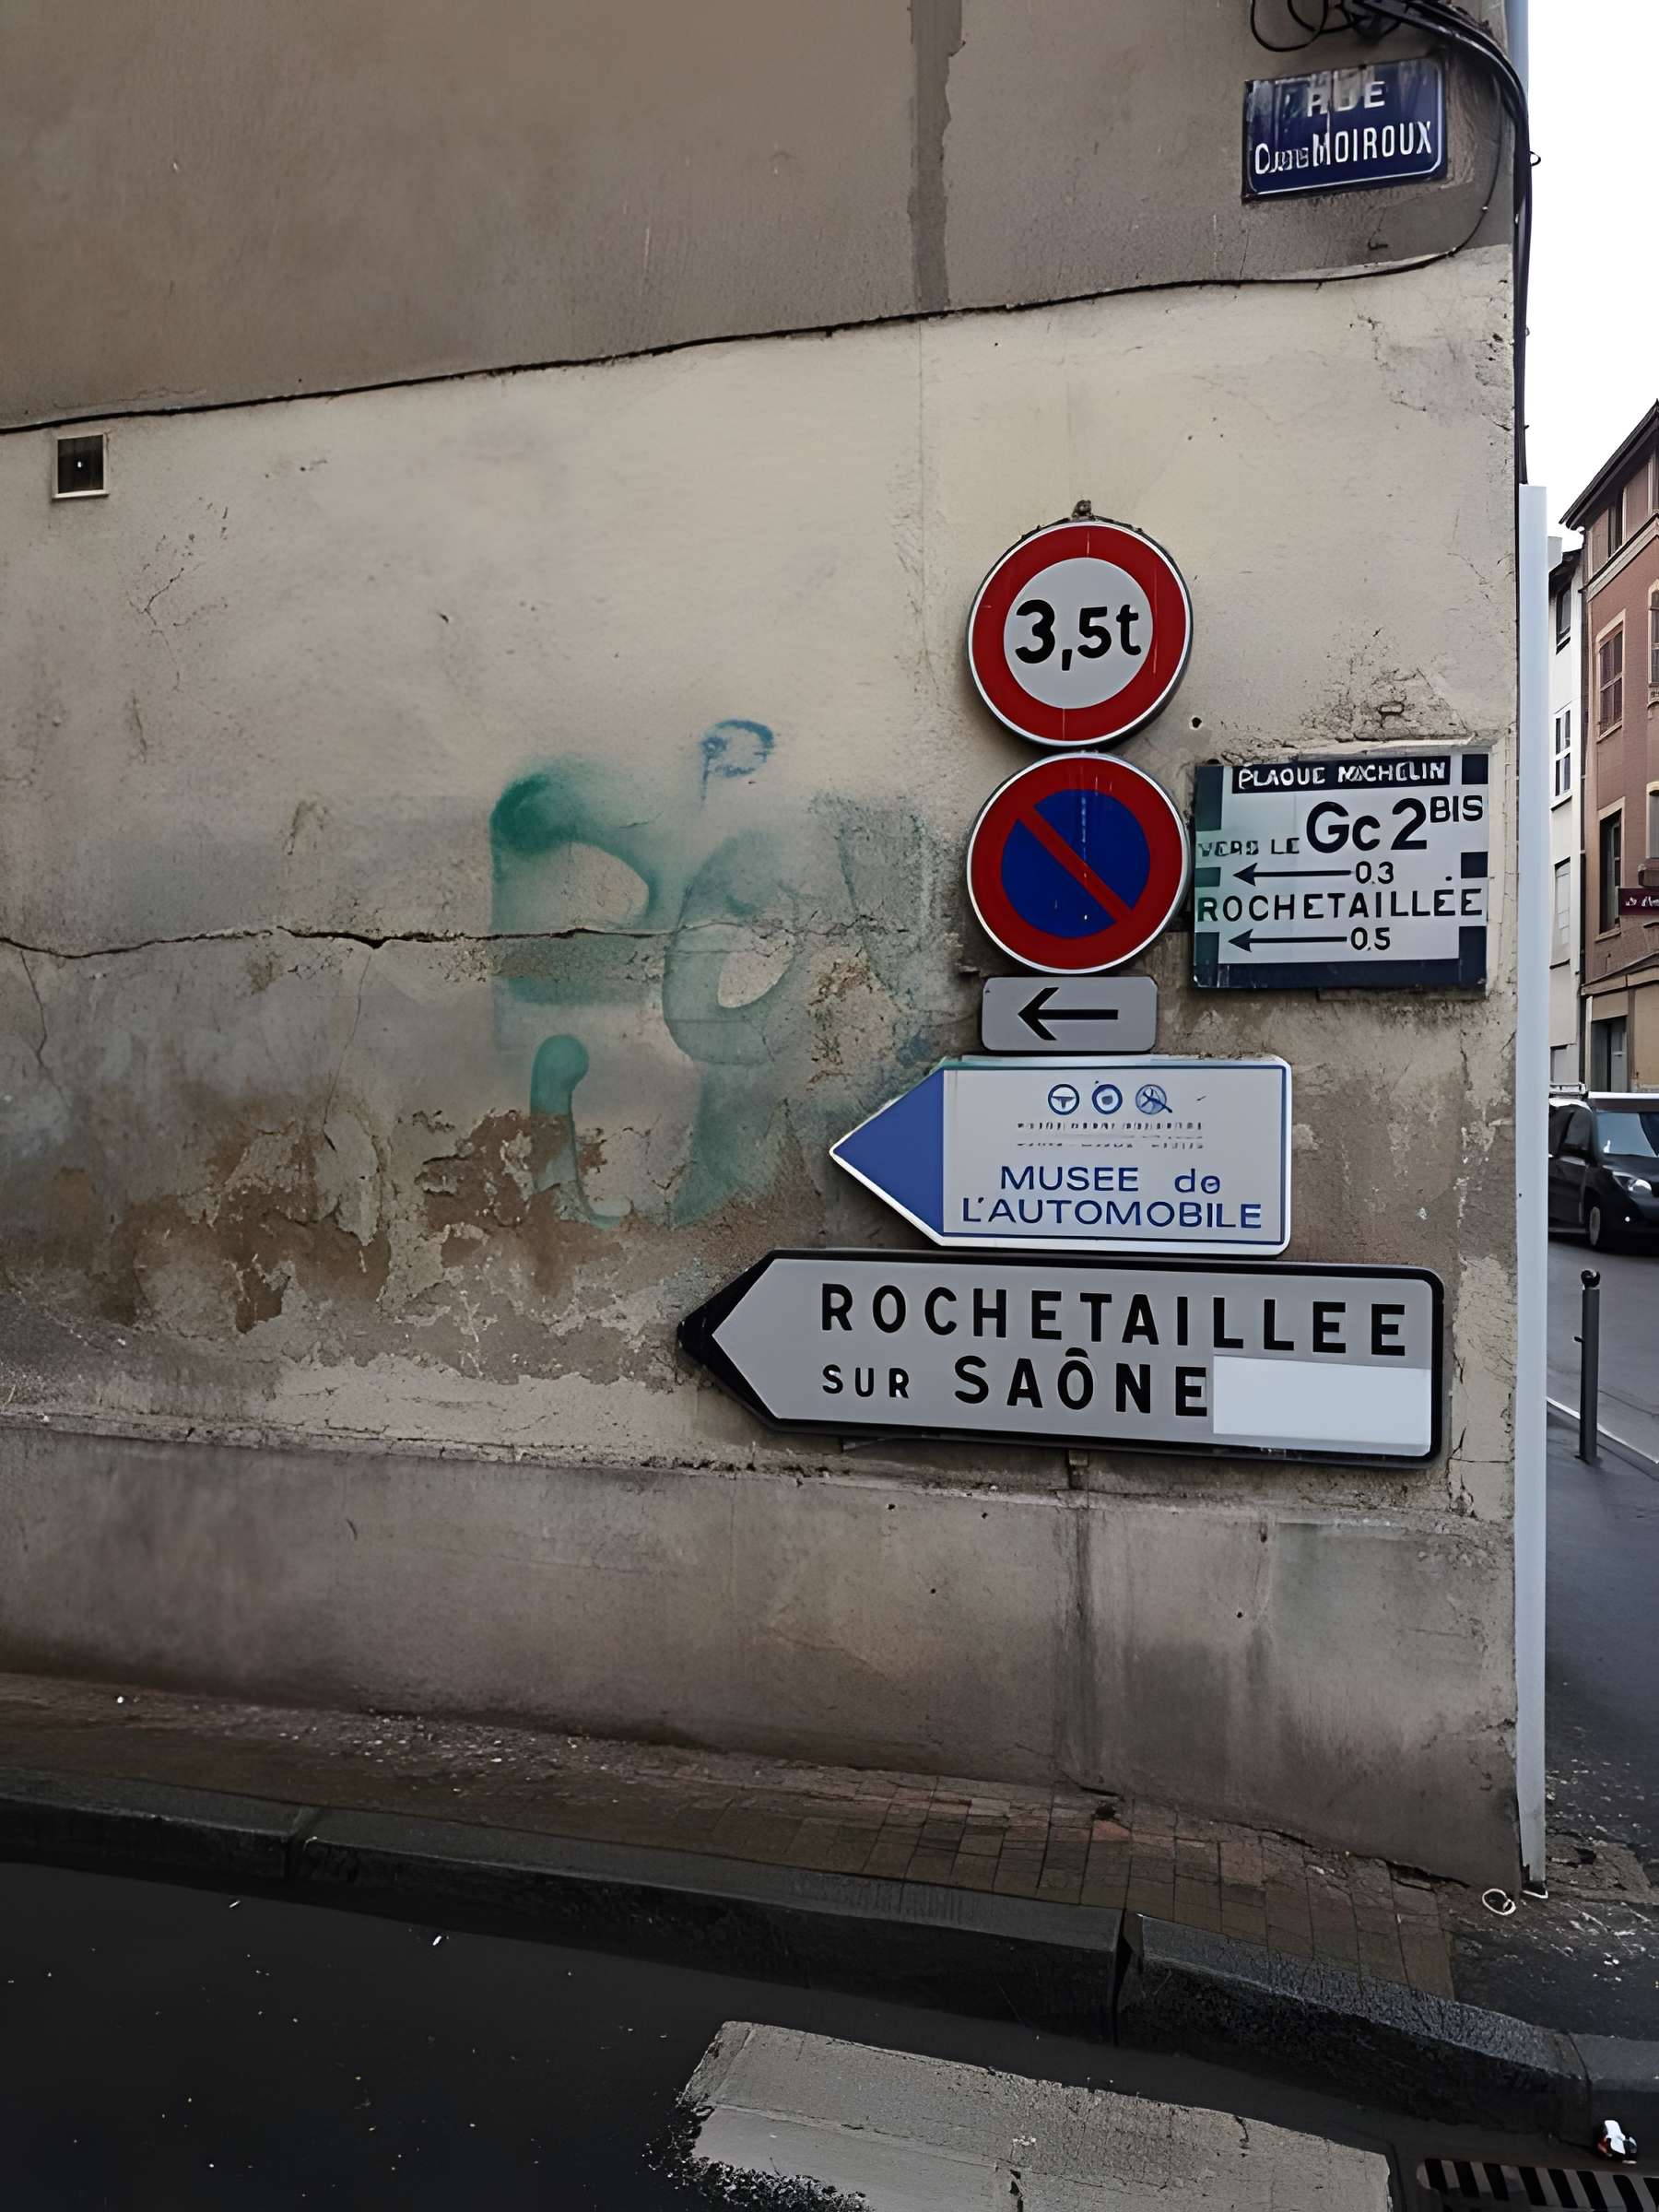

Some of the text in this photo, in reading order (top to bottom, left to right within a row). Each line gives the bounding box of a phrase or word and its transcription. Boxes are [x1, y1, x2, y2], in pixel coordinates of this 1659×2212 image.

[1312, 121, 1431, 167] MOIROUX
[1015, 599, 1141, 671] 3,5t
[1271, 837, 1300, 855] LE
[1000, 1165, 1221, 1194] MUSEE de
[962, 1197, 1262, 1230] L'AUTOMOBILE
[820, 1282, 1406, 1357] ROCHETAILLEE
[822, 1347, 1208, 1418] SUR SAÔNE
